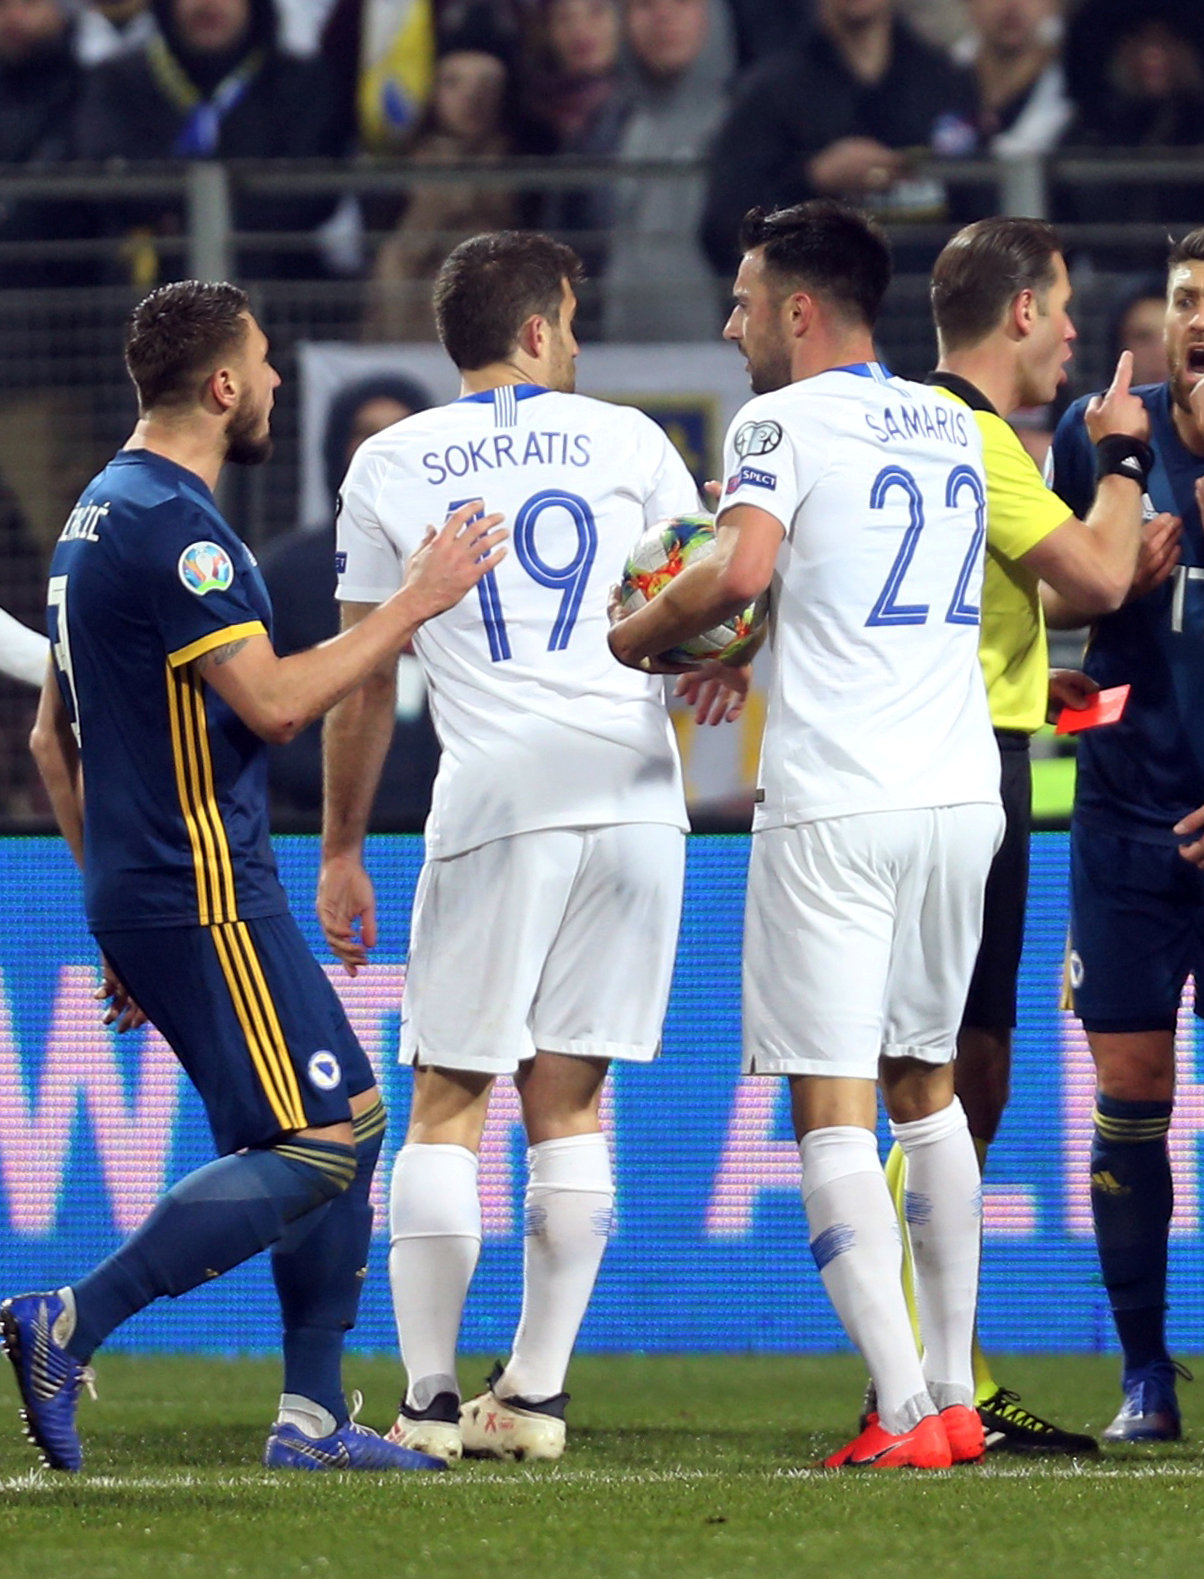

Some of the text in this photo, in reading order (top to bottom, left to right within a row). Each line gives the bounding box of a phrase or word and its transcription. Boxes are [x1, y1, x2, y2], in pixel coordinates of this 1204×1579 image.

[865, 404, 968, 447] SAMARIS
[422, 431, 592, 485] SOKRATIS
[742, 470, 775, 486] SPECT
[864, 464, 986, 628] 22
[445, 488, 599, 663] 19
